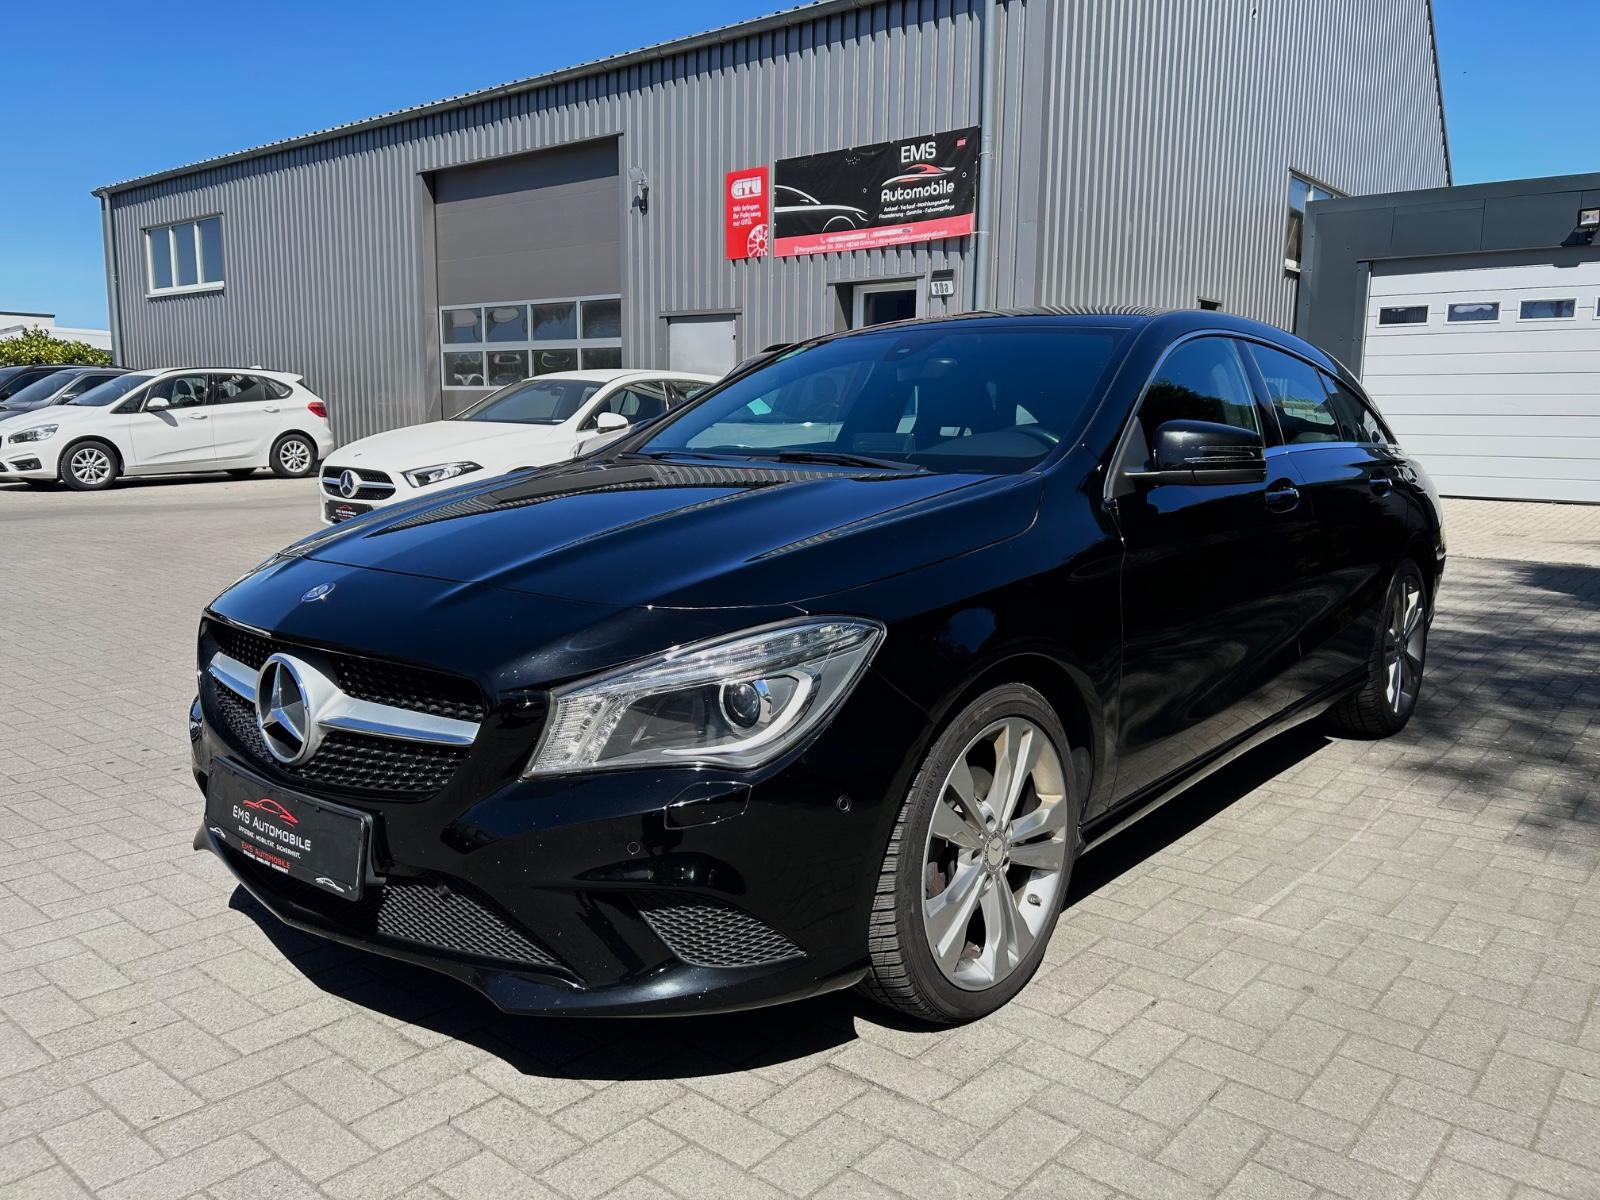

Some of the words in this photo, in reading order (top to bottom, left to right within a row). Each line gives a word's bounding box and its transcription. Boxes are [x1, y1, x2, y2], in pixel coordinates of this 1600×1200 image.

[901, 141, 936, 163] EMS
[881, 180, 955, 203] Automobile
[934, 282, 949, 294] 30a
[232, 805, 250, 824] EMS
[252, 816, 312, 851] AUTOMOBILE
[241, 841, 254, 853] EMS
